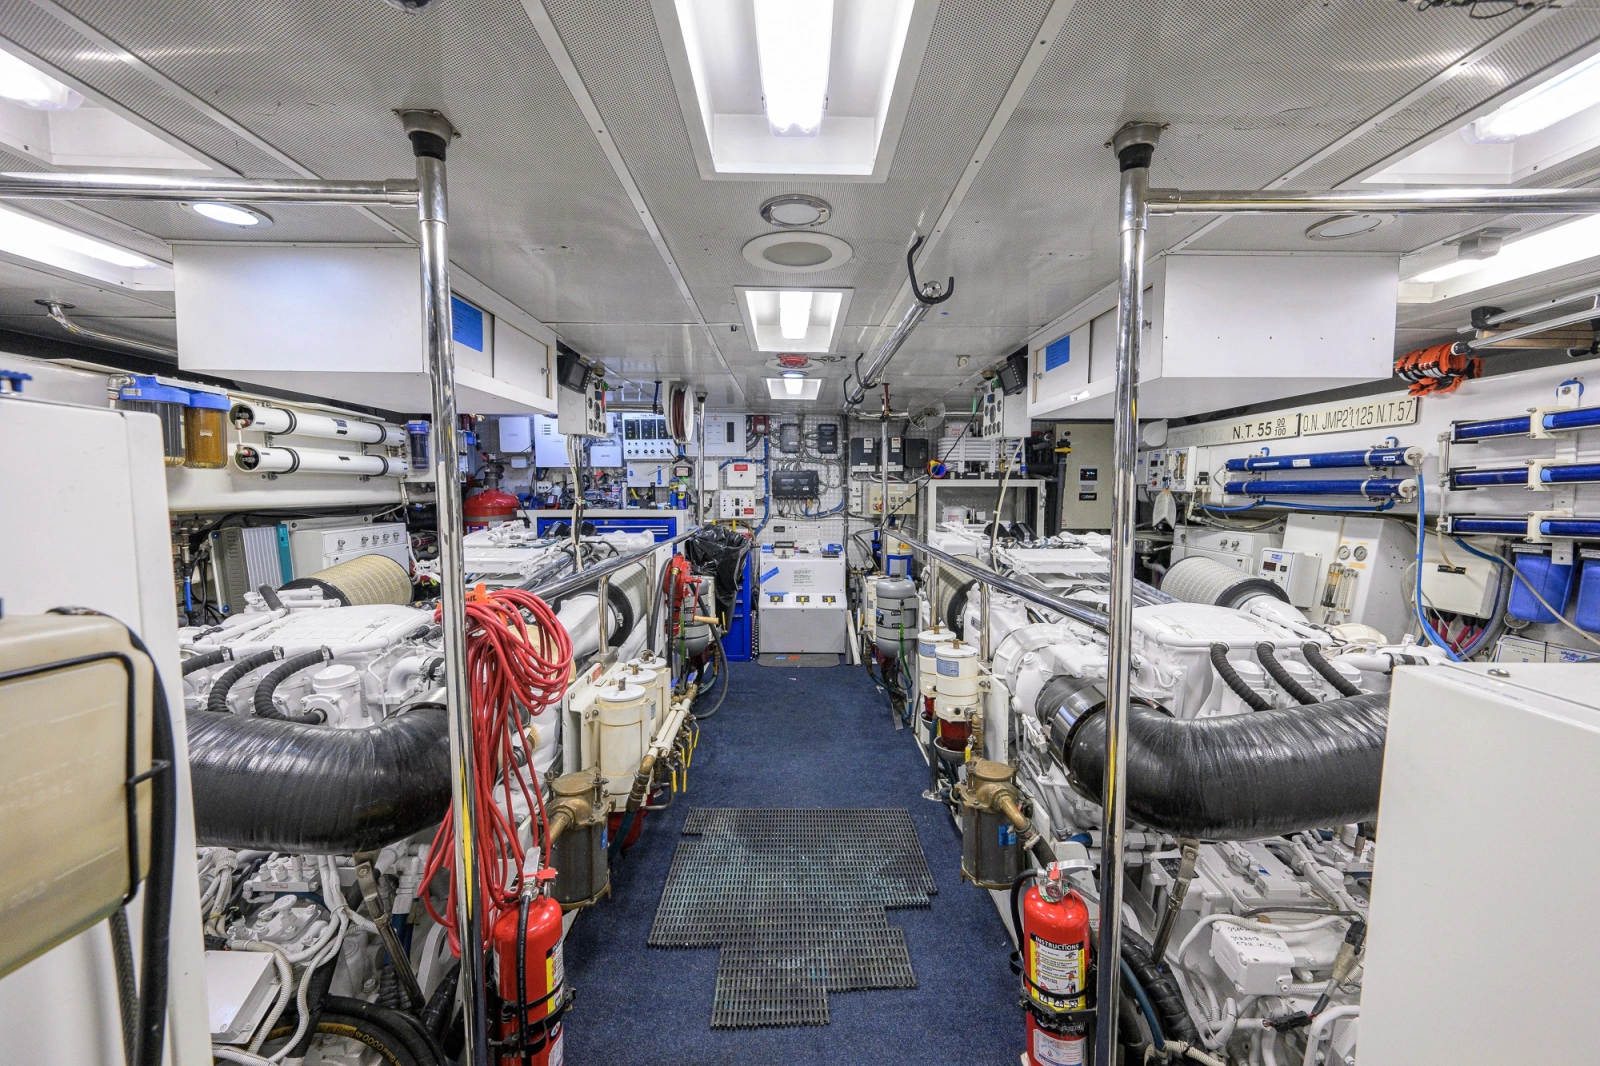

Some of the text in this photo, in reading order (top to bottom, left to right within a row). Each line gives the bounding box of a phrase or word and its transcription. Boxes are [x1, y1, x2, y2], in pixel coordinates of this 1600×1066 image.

[1257, 421, 1272, 437] 55
[1303, 414, 1319, 431] O.N.
[1035, 936, 1080, 950] INSTRUCTIONS
